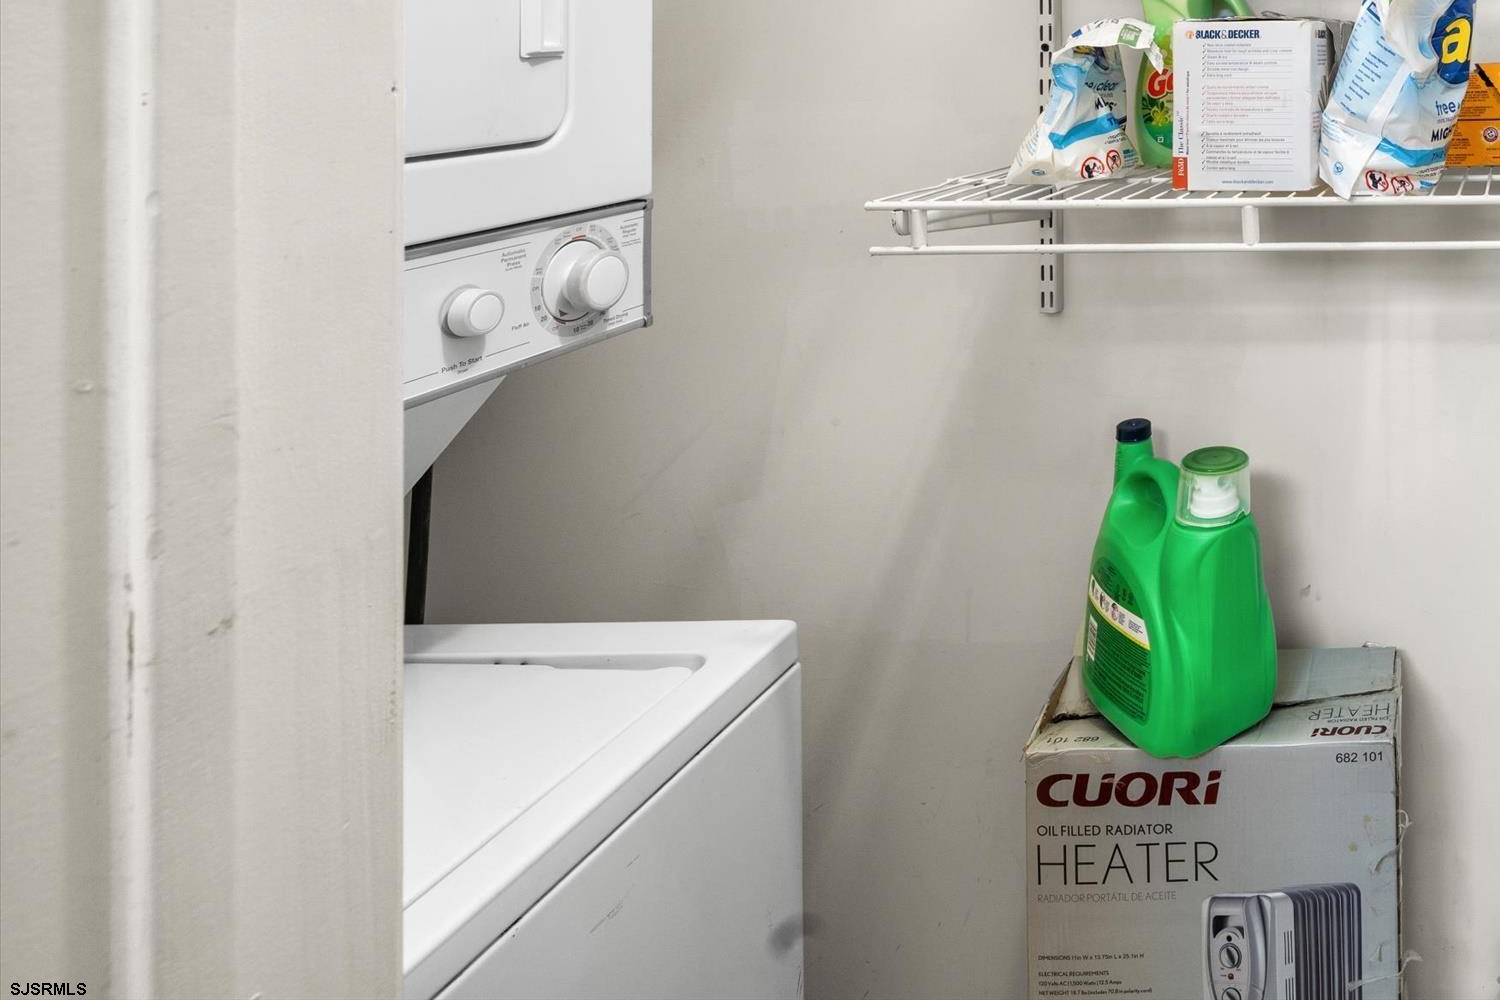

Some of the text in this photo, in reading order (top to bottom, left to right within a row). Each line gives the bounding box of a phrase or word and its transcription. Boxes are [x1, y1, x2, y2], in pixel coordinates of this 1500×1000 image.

[1195, 29, 1260, 40] BLACK&DECKER
[441, 363, 458, 374] Push
[467, 355, 483, 365] Start
[1308, 702, 1391, 721] HEATER
[1335, 751, 1384, 764] 682 101
[1036, 823, 1174, 837] OIL FILLED RADIATOR
[1037, 841, 1220, 886] HEATER
[1037, 893, 1085, 903] RADIADOR
[1131, 891, 1144, 901] DE
[1144, 890, 1177, 900] ACEITE
